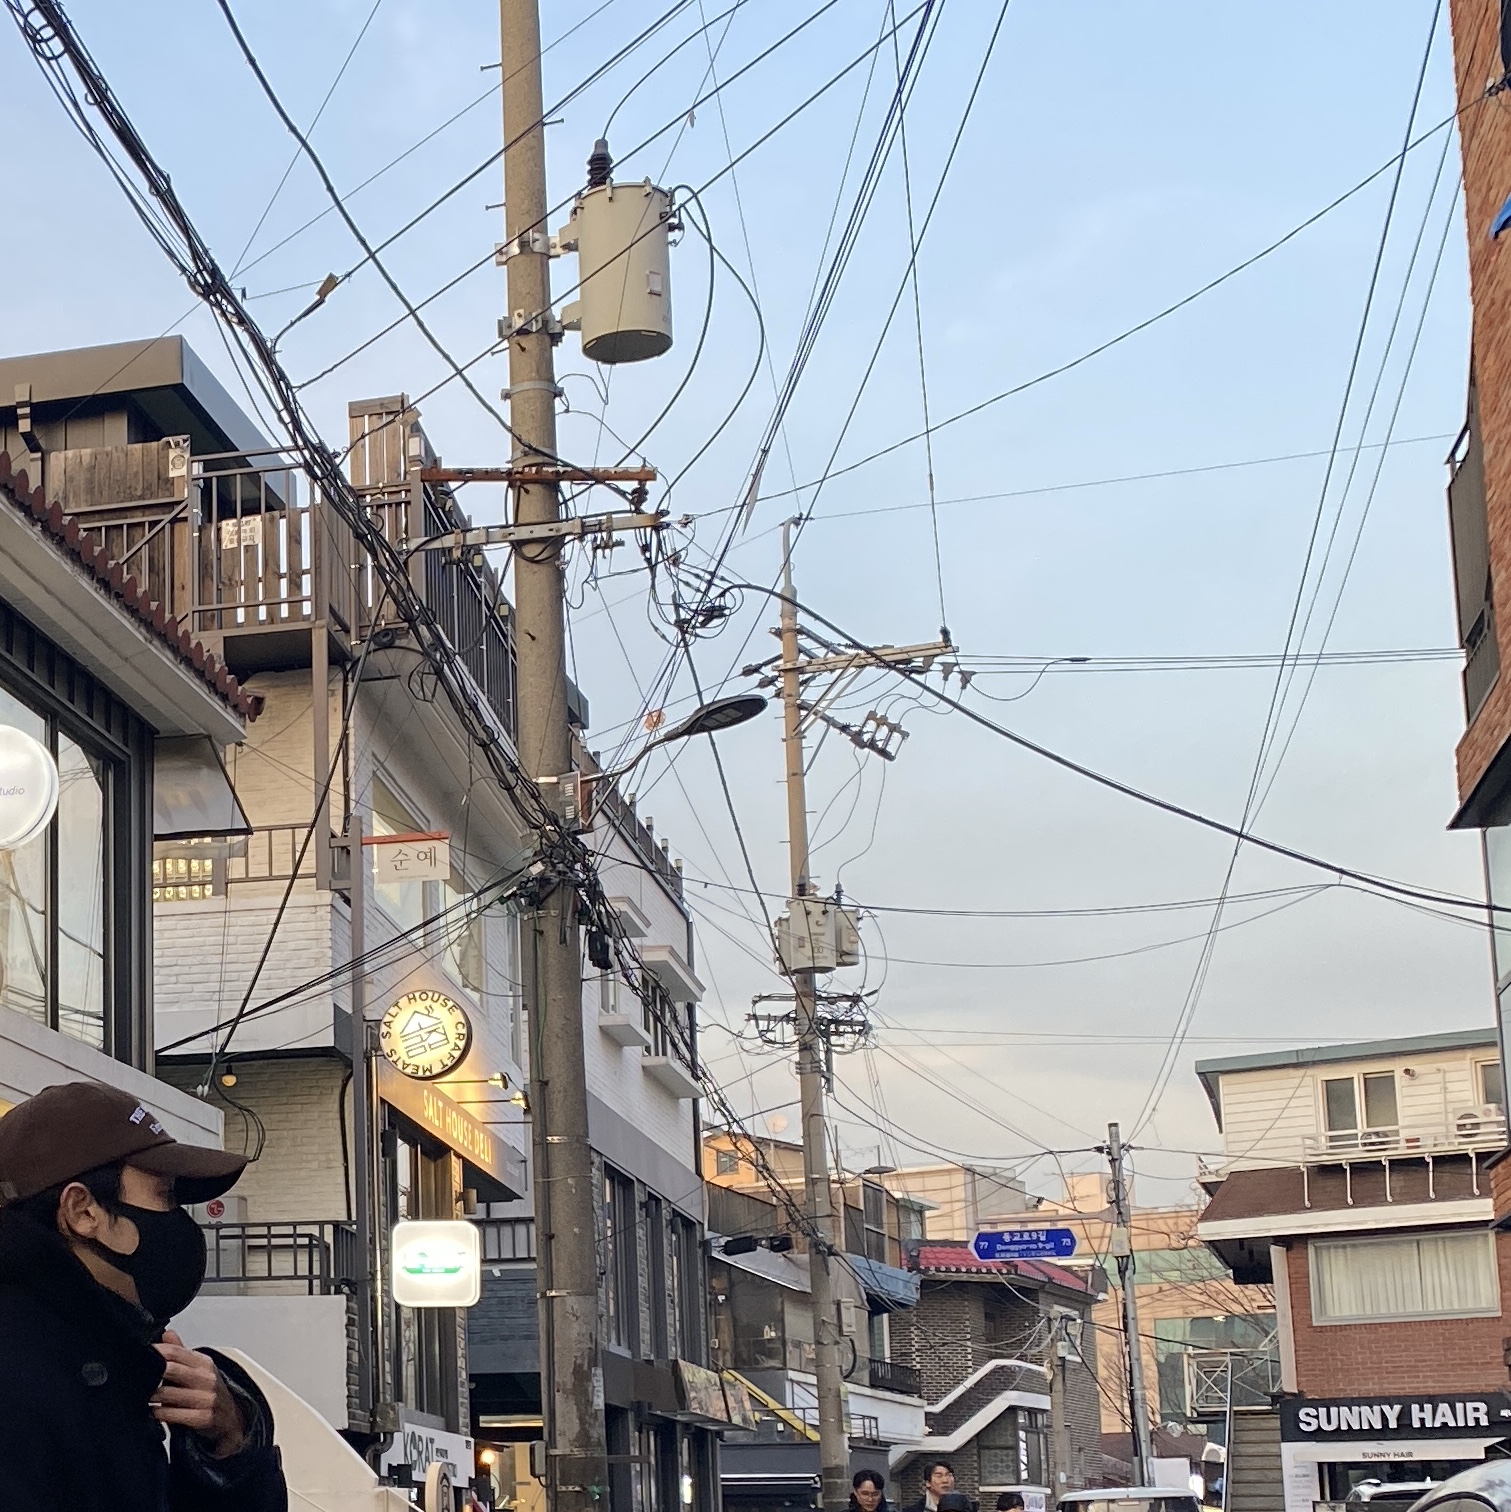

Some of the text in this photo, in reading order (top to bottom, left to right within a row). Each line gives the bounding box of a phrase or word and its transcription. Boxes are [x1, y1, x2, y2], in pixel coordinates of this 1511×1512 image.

[381, 991, 466, 1075] SALT HOUSE CRAFT MEATS
[423, 1088, 492, 1165] SALT HOUSE DELI
[979, 1241, 989, 1249] 77
[1298, 1401, 1489, 1432] SUNNY HAIR
[1362, 1451, 1414, 1460] SUNNY HAIR
